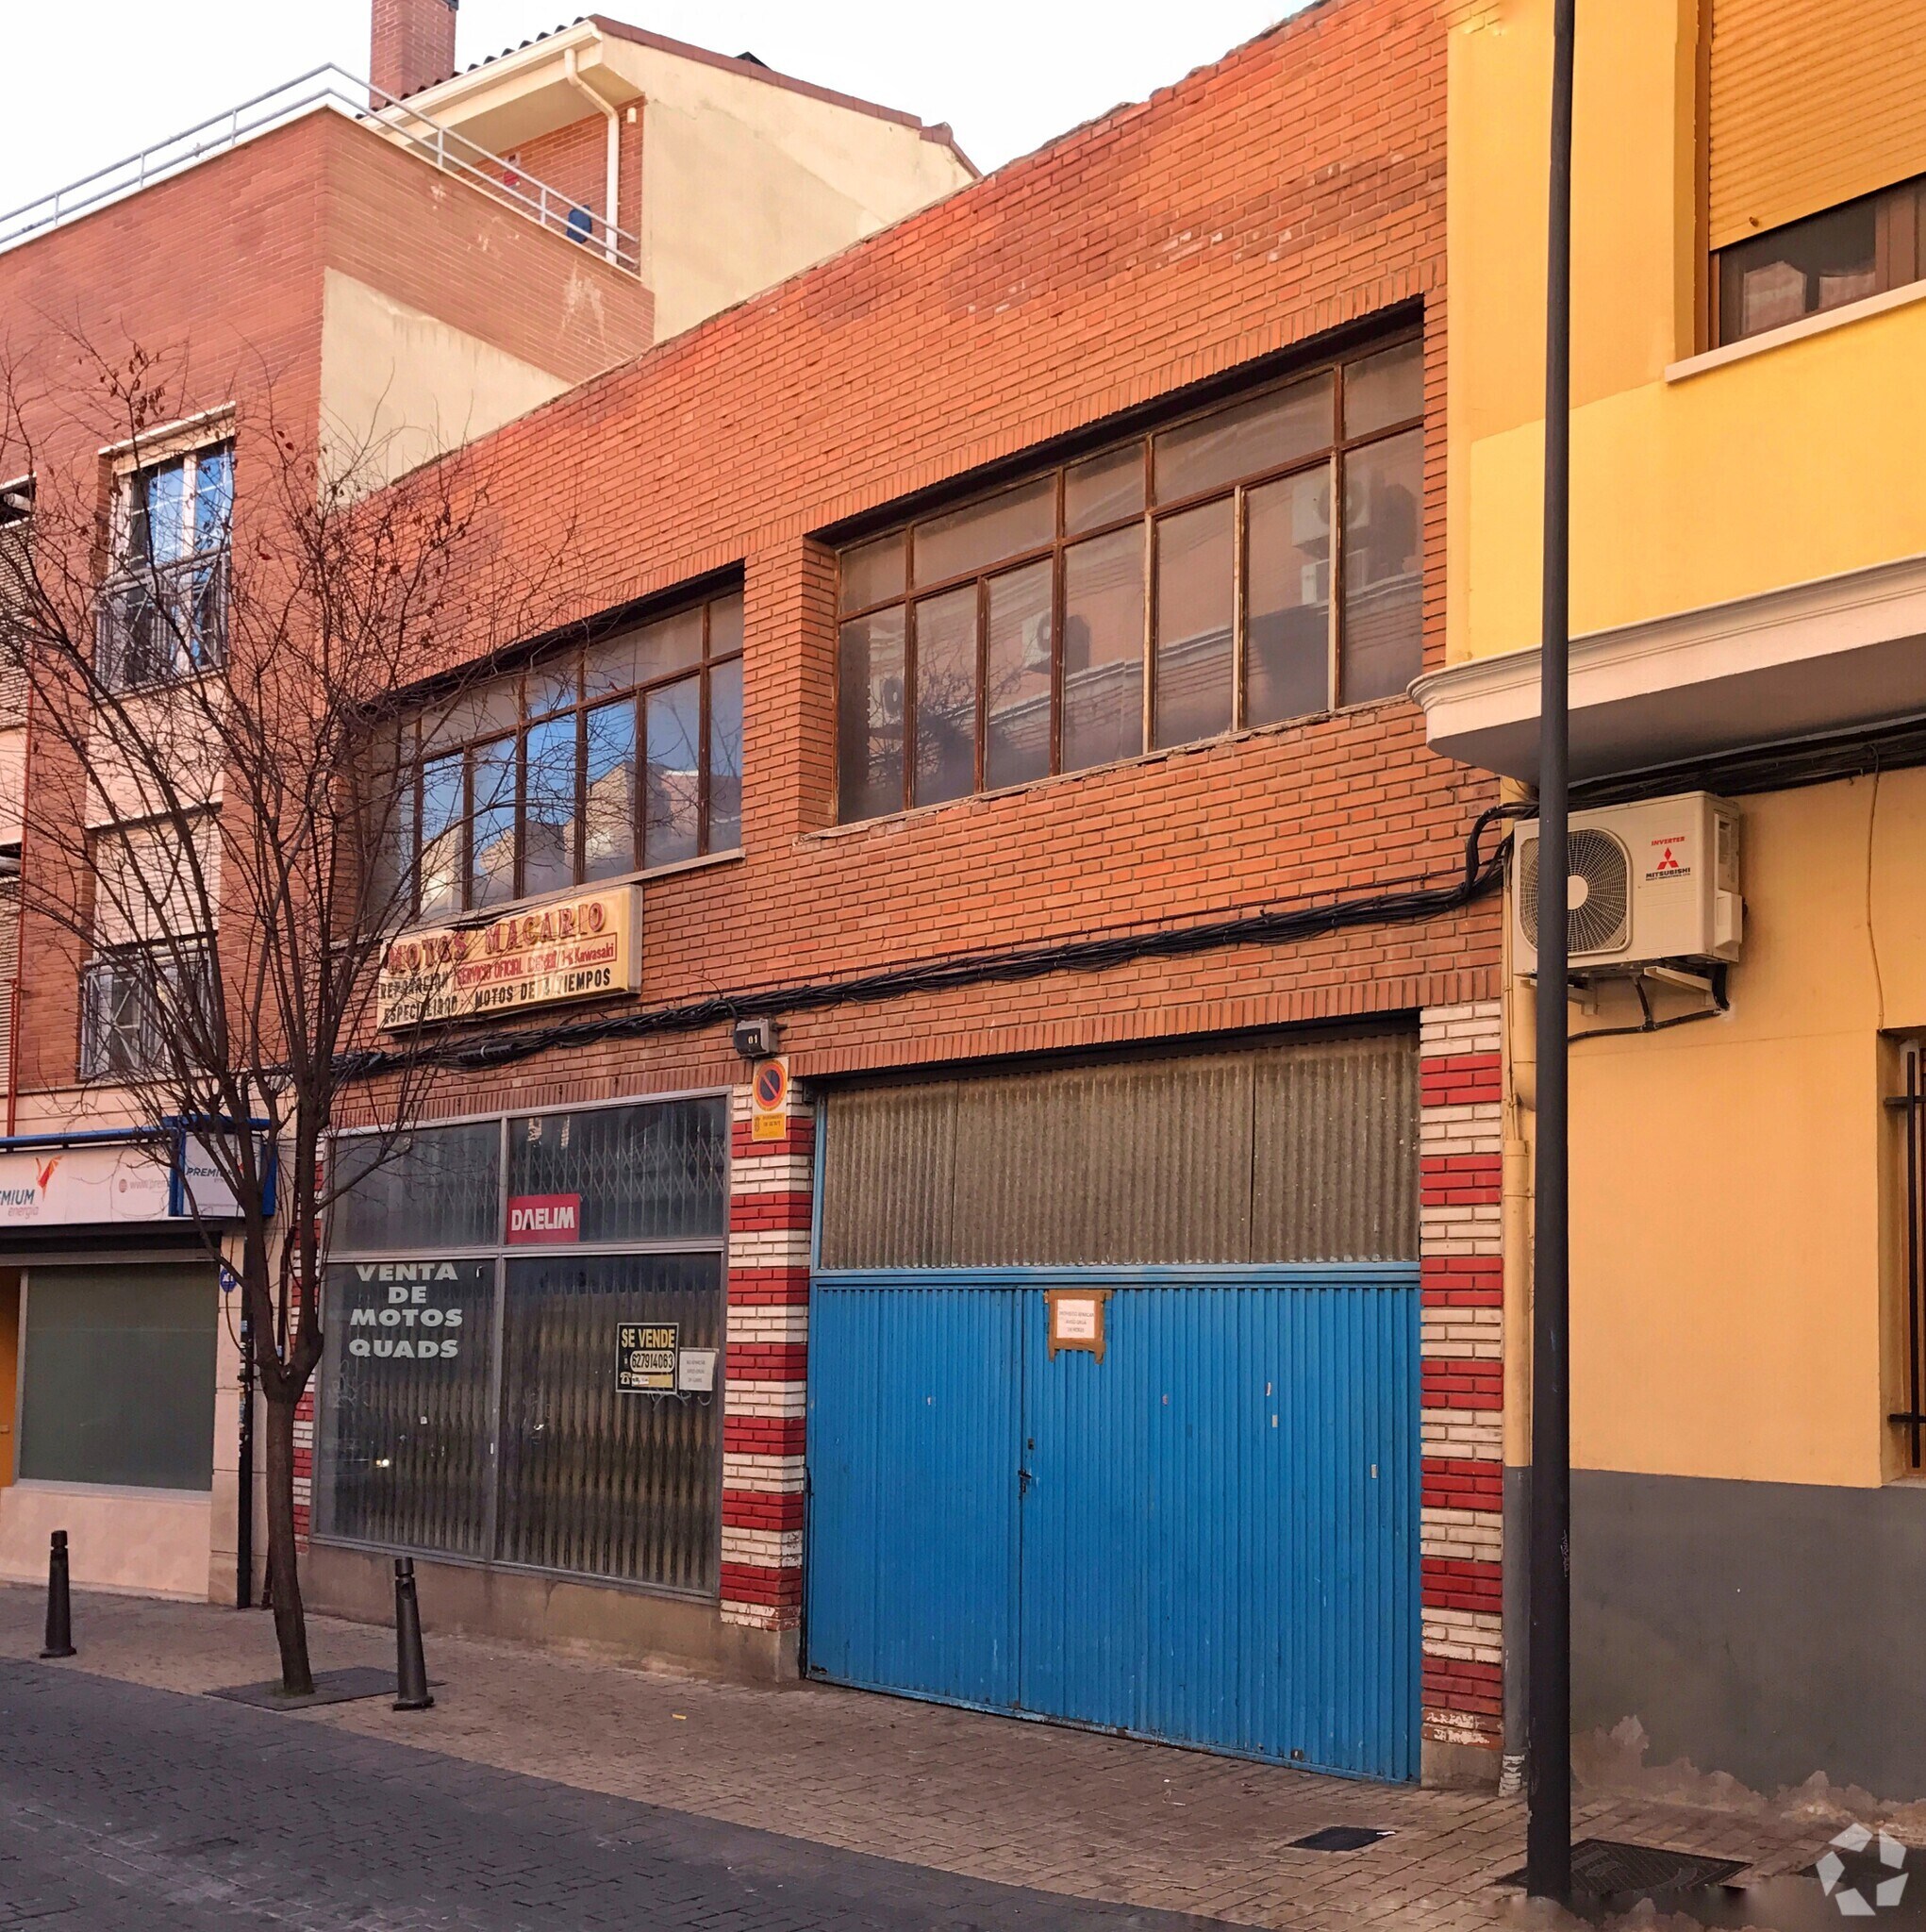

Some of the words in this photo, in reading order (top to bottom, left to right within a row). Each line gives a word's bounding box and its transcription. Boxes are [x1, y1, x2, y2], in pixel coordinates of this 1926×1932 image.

[1652, 836, 1685, 846] INVERTER
[1645, 867, 1691, 878] MITSUBISHI
[388, 929, 469, 975] MOTOS
[485, 902, 606, 955] MACARIO
[494, 957, 523, 978] OFICIAL
[574, 942, 614, 963] Kawasaki
[475, 985, 513, 1008] MOTOS
[521, 980, 535, 1001] DE
[557, 968, 611, 996] TIEMPOS
[0, 1189, 35, 1206] MIUM
[511, 1207, 575, 1231] DAELIM
[356, 1262, 458, 1282] VENTA
[388, 1286, 427, 1304] DE
[350, 1308, 463, 1327] MOTOS
[622, 1328, 636, 1348] SE
[639, 1328, 675, 1349] VENDE
[349, 1339, 459, 1358] QUADS
[631, 1353, 673, 1369] 627914063
